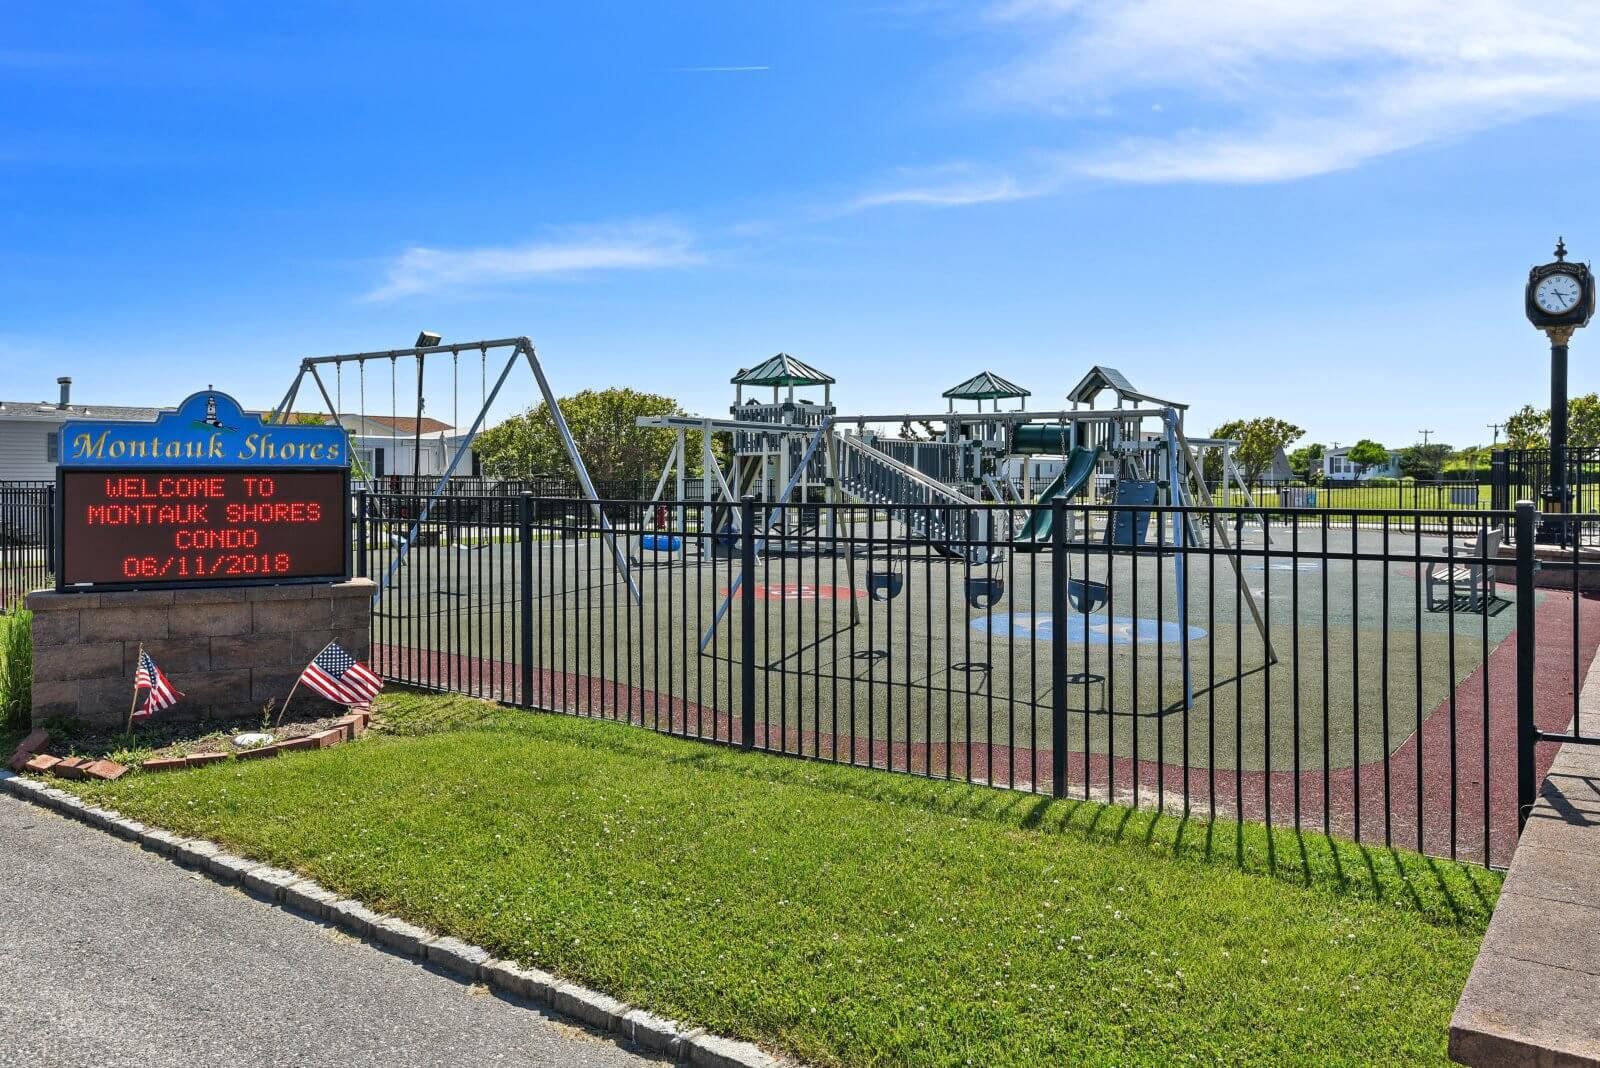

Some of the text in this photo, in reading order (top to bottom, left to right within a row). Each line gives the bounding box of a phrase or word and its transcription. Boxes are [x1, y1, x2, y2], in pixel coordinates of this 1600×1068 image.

[72, 430, 340, 461] Montauk Shores
[105, 477, 275, 499] WELCOME TO
[87, 502, 321, 526] MONTAUK SHORES
[175, 528, 259, 551] CONDO
[122, 553, 290, 577] 06/11/2018
